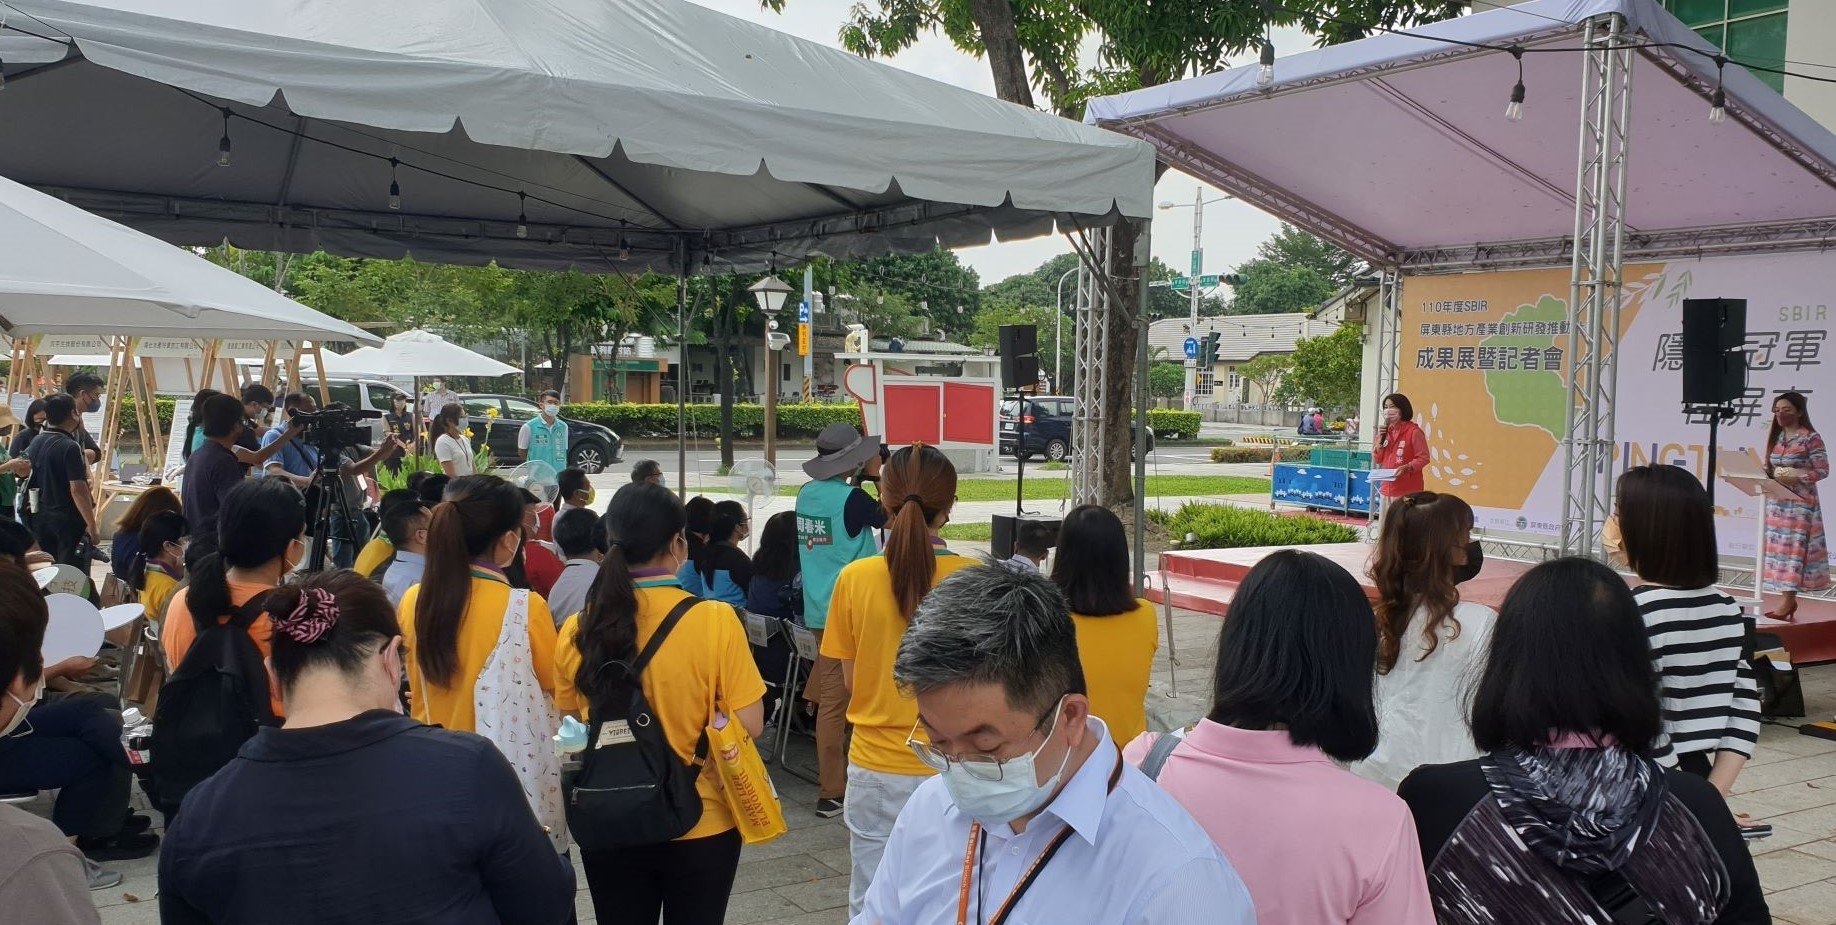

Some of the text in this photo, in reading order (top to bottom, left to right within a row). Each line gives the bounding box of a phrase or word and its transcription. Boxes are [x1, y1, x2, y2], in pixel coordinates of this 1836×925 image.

[1422, 301, 1488, 313] 110年度SBIR
[1779, 305, 1827, 322] SBIR
[1416, 346, 1563, 371] 成果展暨記者會
[1653, 330, 1827, 371] 隱冠軍
